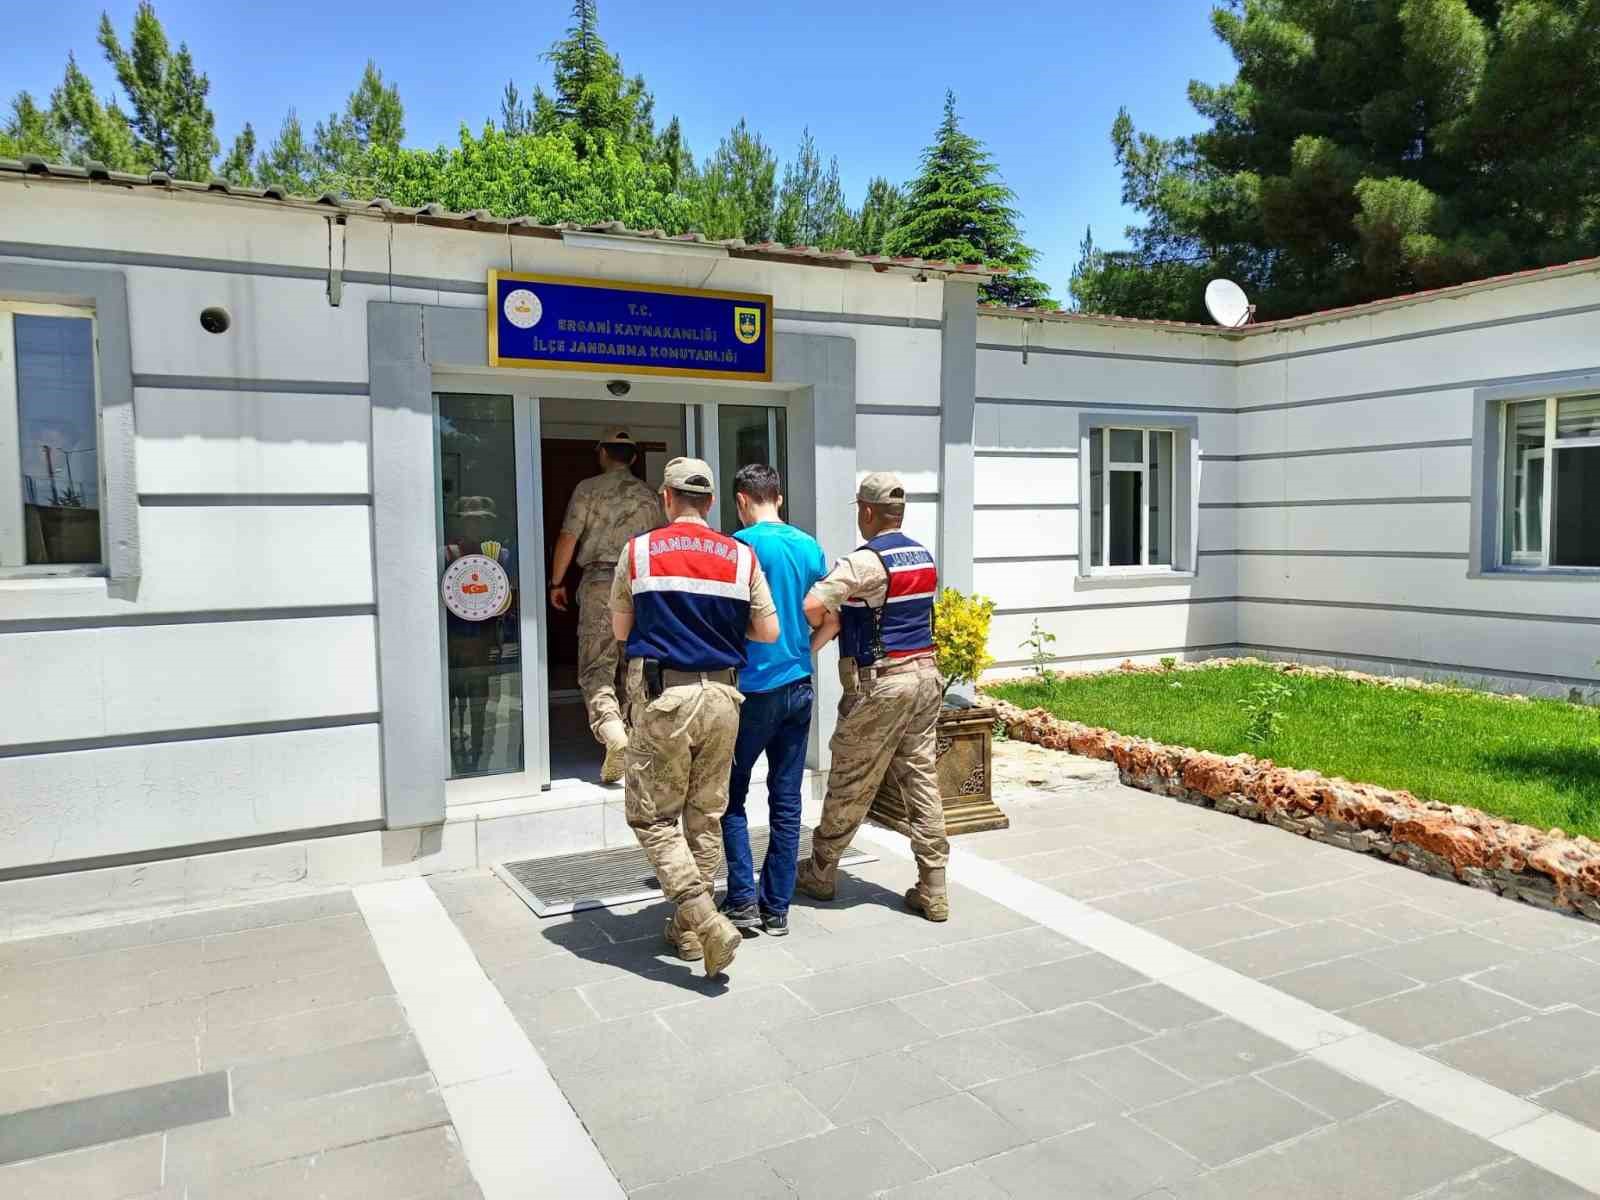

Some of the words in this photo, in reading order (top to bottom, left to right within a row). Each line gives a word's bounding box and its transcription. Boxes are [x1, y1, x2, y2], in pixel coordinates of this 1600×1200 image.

[628, 303, 652, 317] T.C.
[558, 319, 610, 334] ERGANİ
[533, 335, 565, 353] İLÇE
[569, 341, 647, 357] JANDARMA
